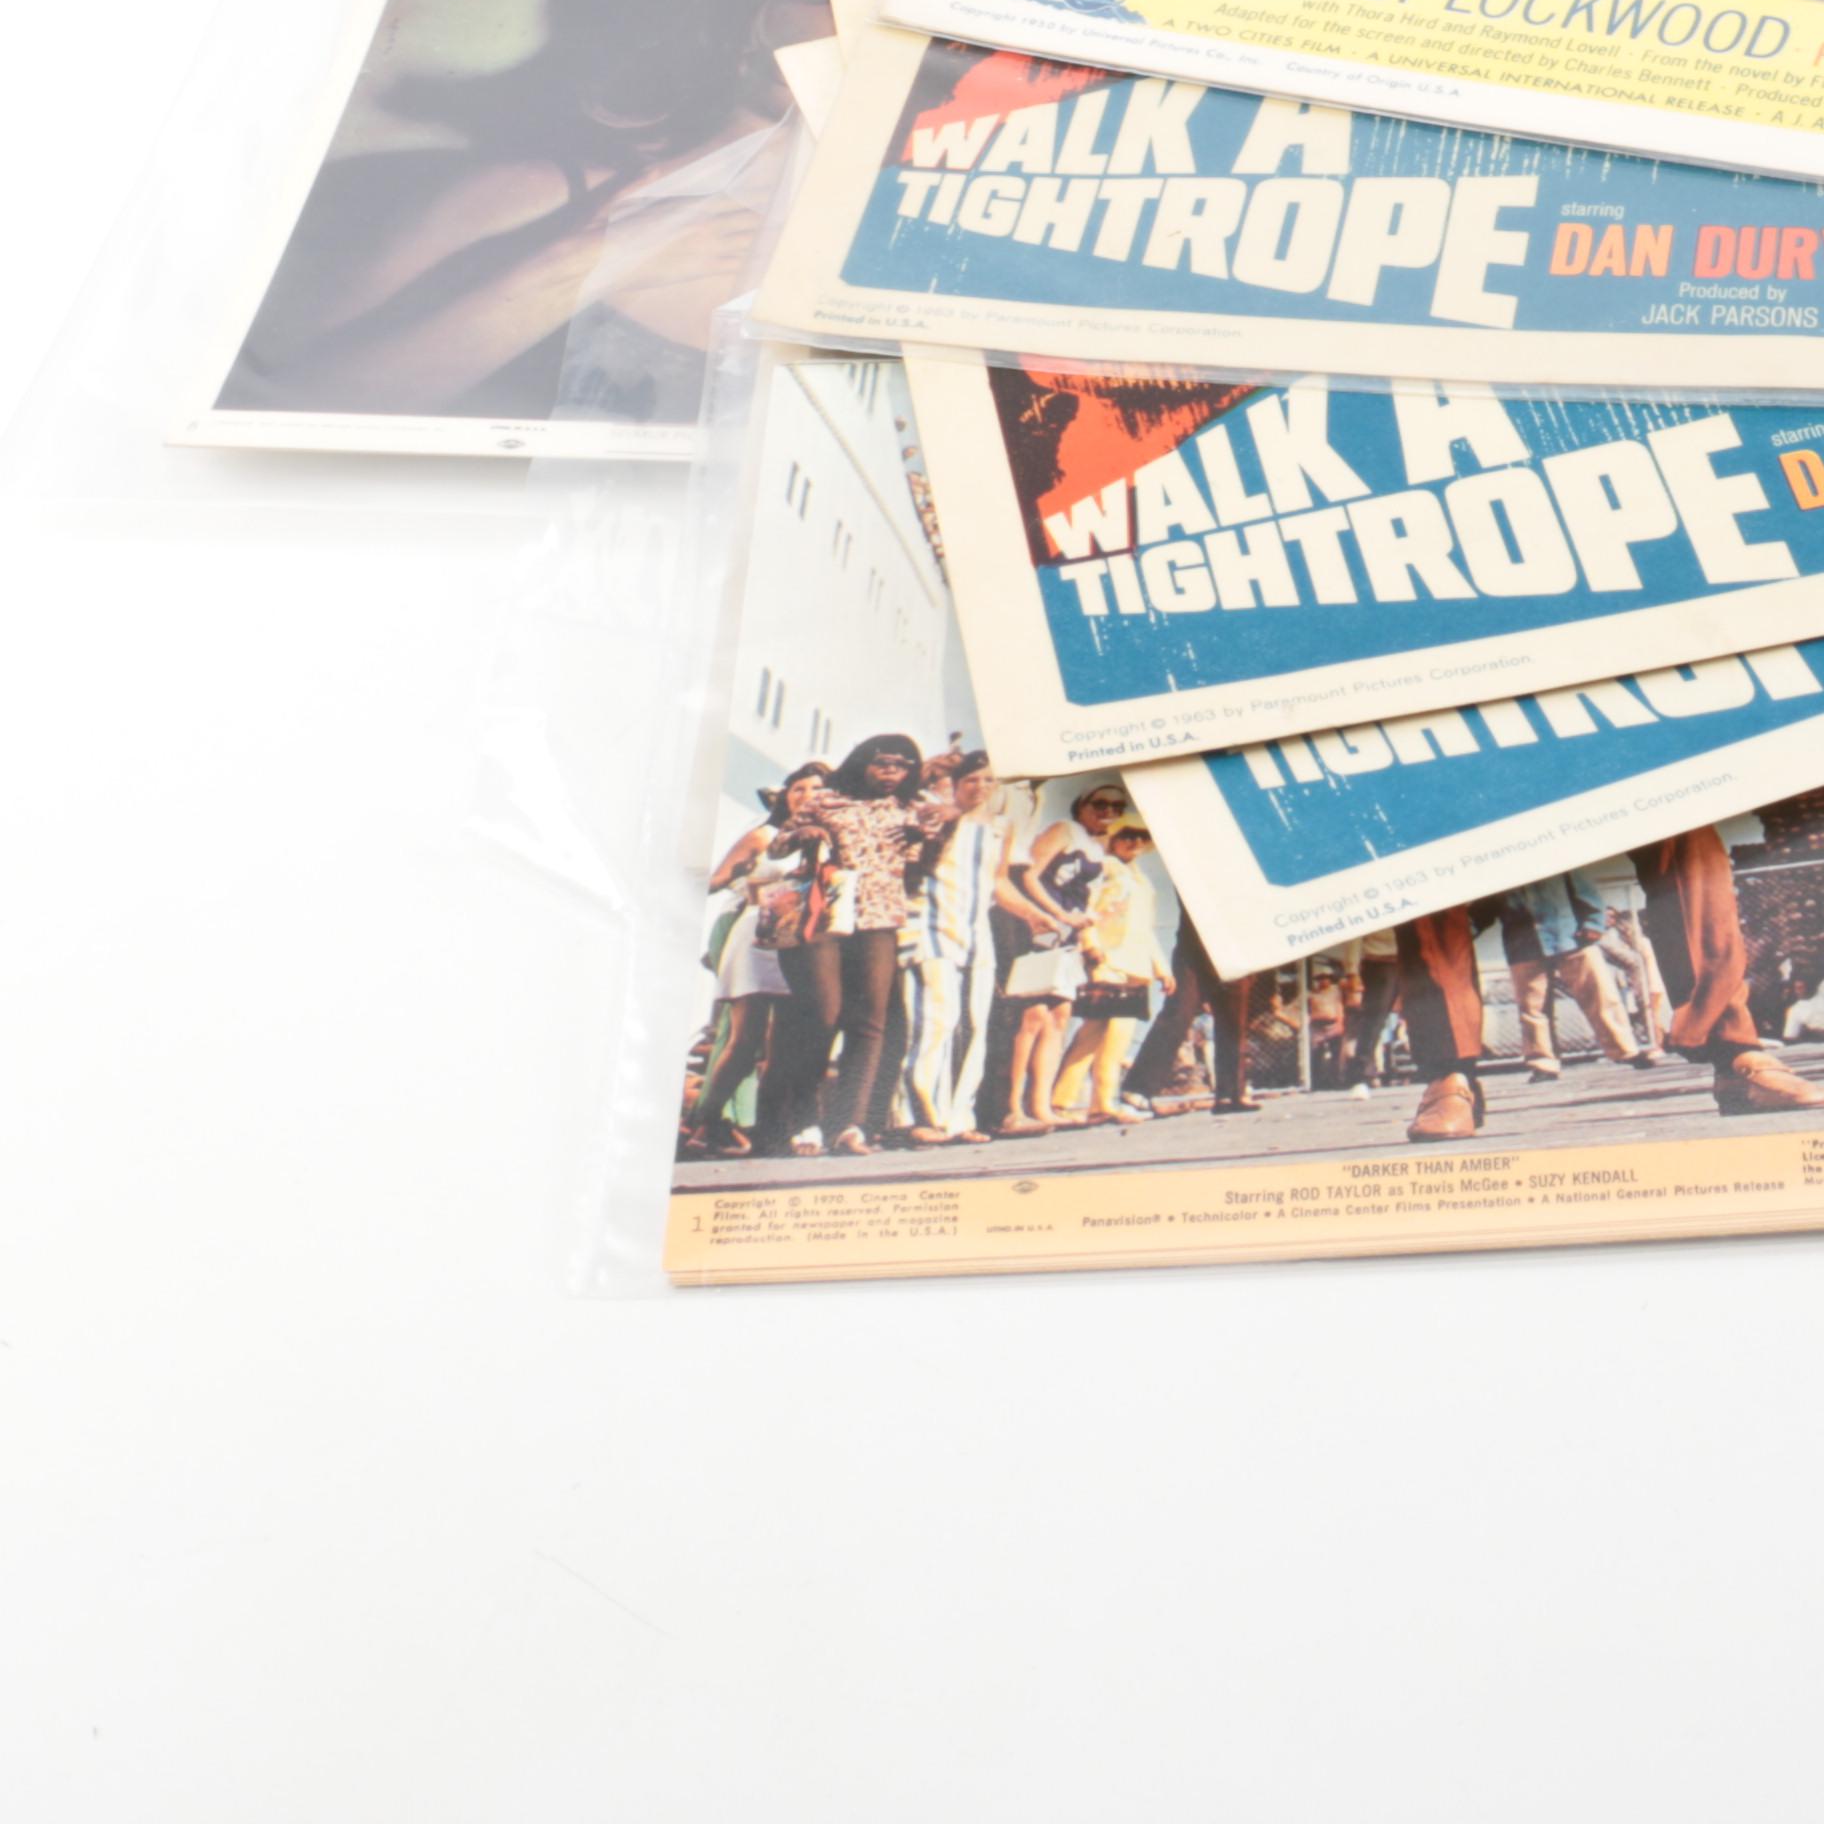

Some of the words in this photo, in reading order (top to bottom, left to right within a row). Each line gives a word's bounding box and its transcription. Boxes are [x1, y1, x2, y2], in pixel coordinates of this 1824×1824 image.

[1185, 19, 1232, 38] TWO
[1238, 29, 1294, 50] CITIES
[1299, 39, 1342, 56] FILM
[1389, 54, 1492, 81] UNIVERSAL
[1500, 69, 1657, 105] INTERNATIONAL
[1665, 92, 1745, 118] RELEASE
[1213, 1, 1289, 28] Adapted
[1291, 15, 1317, 35] for
[1319, 20, 1351, 38] the
[1354, 28, 1417, 49] screen
[1421, 37, 1454, 54] and
[1458, 43, 1533, 67] directed
[1535, 54, 1560, 74] by
[1563, 57, 1632, 81] Charles
[1637, 67, 1712, 92] Bennett
[1734, 81, 1822, 108] Produced
[1346, 1, 1396, 22] Thora
[1400, 11, 1437, 29] Hird
[1441, 19, 1474, 37] and
[1480, 25, 1562, 53] Raymond
[1566, 37, 1622, 59] Lovell
[1641, 49, 1689, 70] From
[1692, 57, 1724, 75] the
[1729, 63, 1779, 83] novel
[1782, 70, 1806, 90] by
[912, 79, 1207, 174] WALK
[1233, 92, 1351, 175] A
[1561, 202, 1624, 220] starring
[897, 171, 1537, 329] TIGHTROPE
[1550, 223, 1673, 277] DAN
[1641, 303, 1701, 327] JACK
[1710, 305, 1818, 330] PARSONS
[1679, 282, 1760, 300] Produced
[1767, 285, 1787, 303] by
[1044, 376, 1370, 560] WALK
[1391, 379, 1530, 485] A
[1060, 413, 1801, 616] TIGHTROPE
[1060, 716, 1146, 745] Copyright
[1249, 683, 1348, 716] Paramount
[1352, 670, 1423, 696] Pictures
[1067, 740, 1126, 764] Printed
[1273, 890, 1361, 929] Copyright
[1383, 869, 1428, 893] 1963
[1433, 862, 1457, 883] by
[1460, 825, 1556, 868] Paramount
[1560, 804, 1630, 839] Pictures
[1287, 916, 1346, 946] Printed
[1224, 1189, 1284, 1207] Starring
[1289, 1186, 1321, 1202] ROD
[1327, 1183, 1382, 1201] TAYLOR
[1388, 1185, 1403, 1197] as
[1409, 1180, 1455, 1196] Travis
[1460, 1177, 1509, 1194] McGee
[1528, 1174, 1567, 1189] SUZY
[1572, 1169, 1638, 1186] KENDALL
[1342, 1161, 1409, 1180] "DARKER
[1414, 1159, 1454, 1175] THAN
[1459, 1155, 1521, 1173] AMBER"
[715, 1196, 776, 1211] Copyright
[1181, 1209, 1258, 1224] Technicolor
[1291, 1205, 1340, 1218] Cinema
[1345, 1202, 1390, 1215] Center
[1396, 1199, 1432, 1213] Films
[1438, 1195, 1521, 1211] Presentation
[1555, 1190, 1611, 1203] National
[1616, 1187, 1667, 1200] General
[1673, 1184, 1728, 1196] Pictures
[1734, 1179, 1785, 1193] Release
